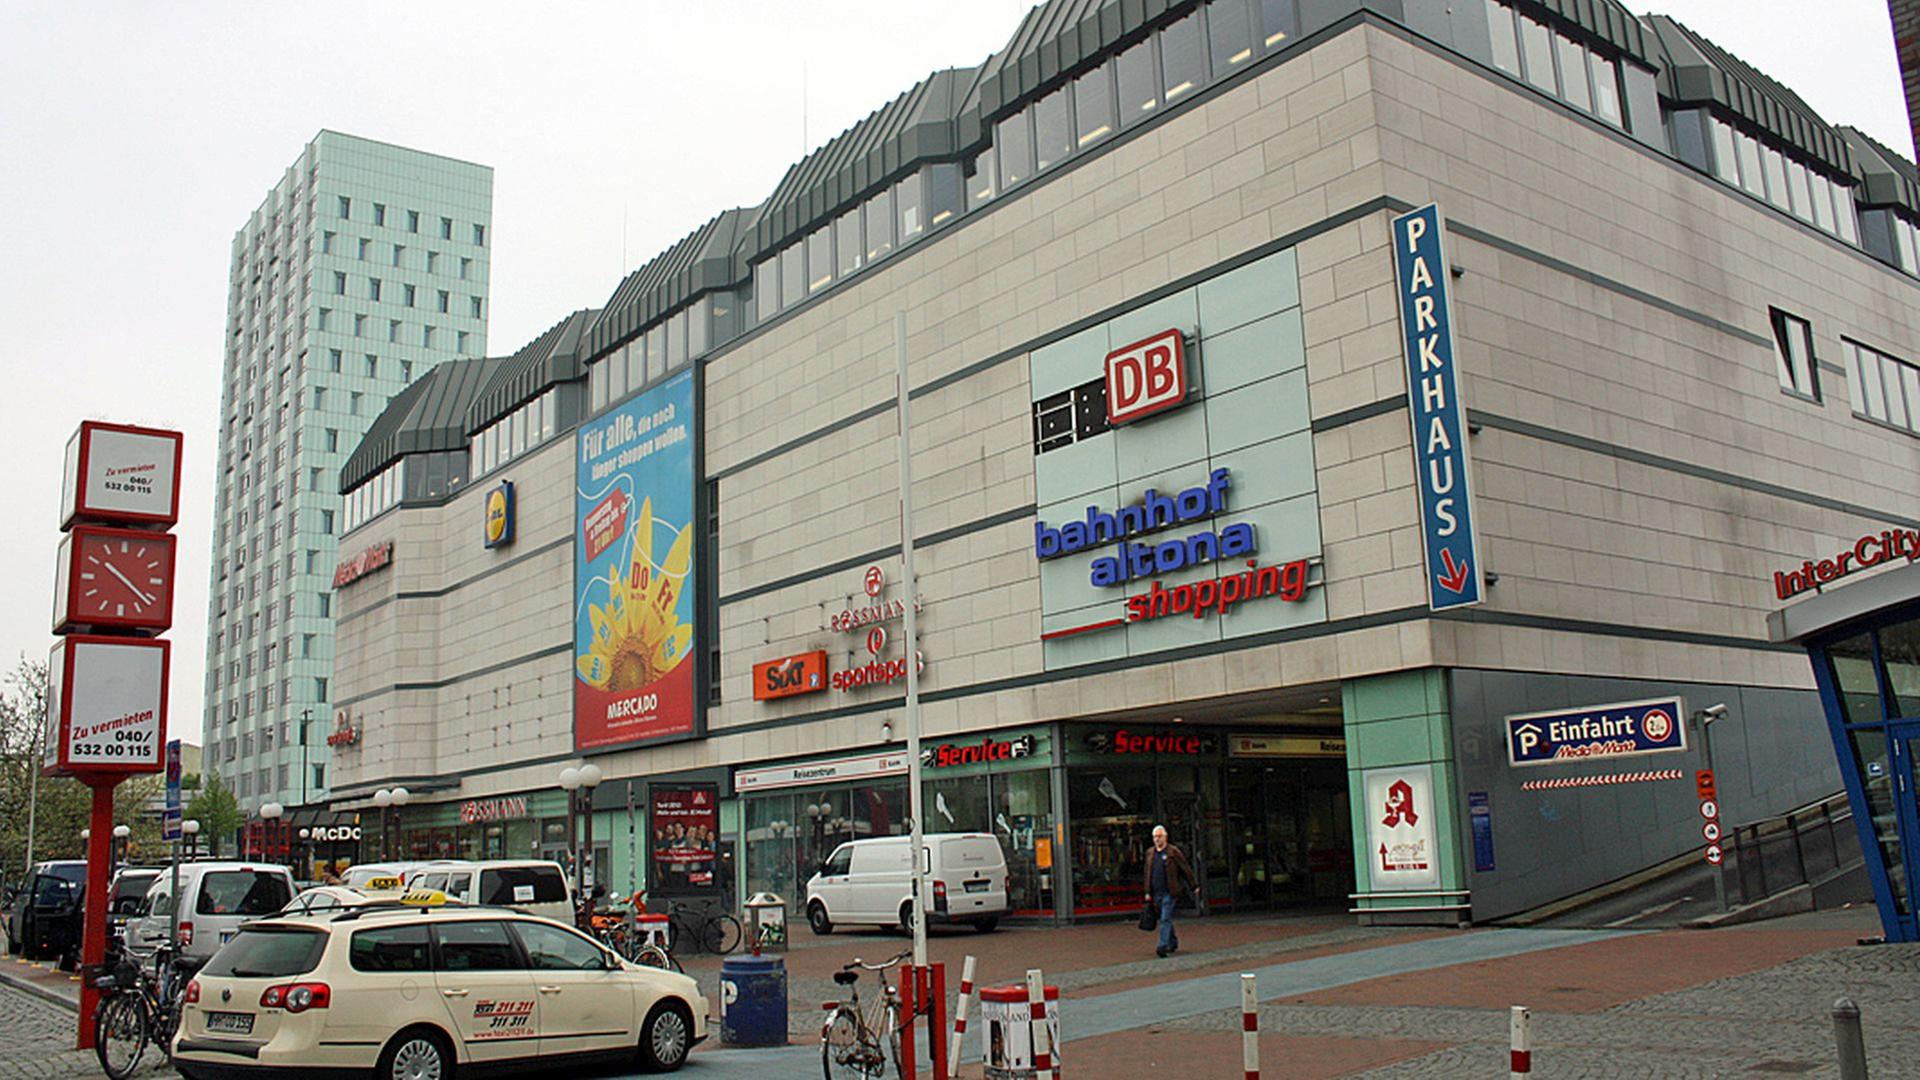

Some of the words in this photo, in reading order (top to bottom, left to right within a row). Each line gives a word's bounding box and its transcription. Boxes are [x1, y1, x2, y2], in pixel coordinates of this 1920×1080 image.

[1115, 345, 1175, 410] DB
[1407, 217, 1458, 537] PARKHAUS
[583, 428, 603, 464] Für
[606, 413, 637, 451] alle,
[105, 481, 122, 490] 532
[123, 484, 136, 492] 00
[137, 486, 152, 494] 115
[129, 476, 153, 485] 040/
[1035, 467, 1231, 559] bahnhof
[1090, 521, 1256, 588] altona
[1773, 528, 1920, 601] InterCity
[1126, 559, 1307, 622] shopping
[607, 693, 658, 719] MERCADO
[73, 726, 89, 741] Zu
[92, 709, 154, 735] vermieten
[115, 730, 153, 743] 040/
[1550, 716, 1636, 742] Einfahrt
[74, 744, 102, 756] 532
[105, 744, 124, 756] 00
[129, 745, 151, 757] 115
[937, 738, 1011, 768] Service
[1114, 729, 1201, 754] Service
[460, 797, 528, 824] ROSSMANN
[496, 1001, 515, 1012] 211
[516, 1000, 535, 1012] 211
